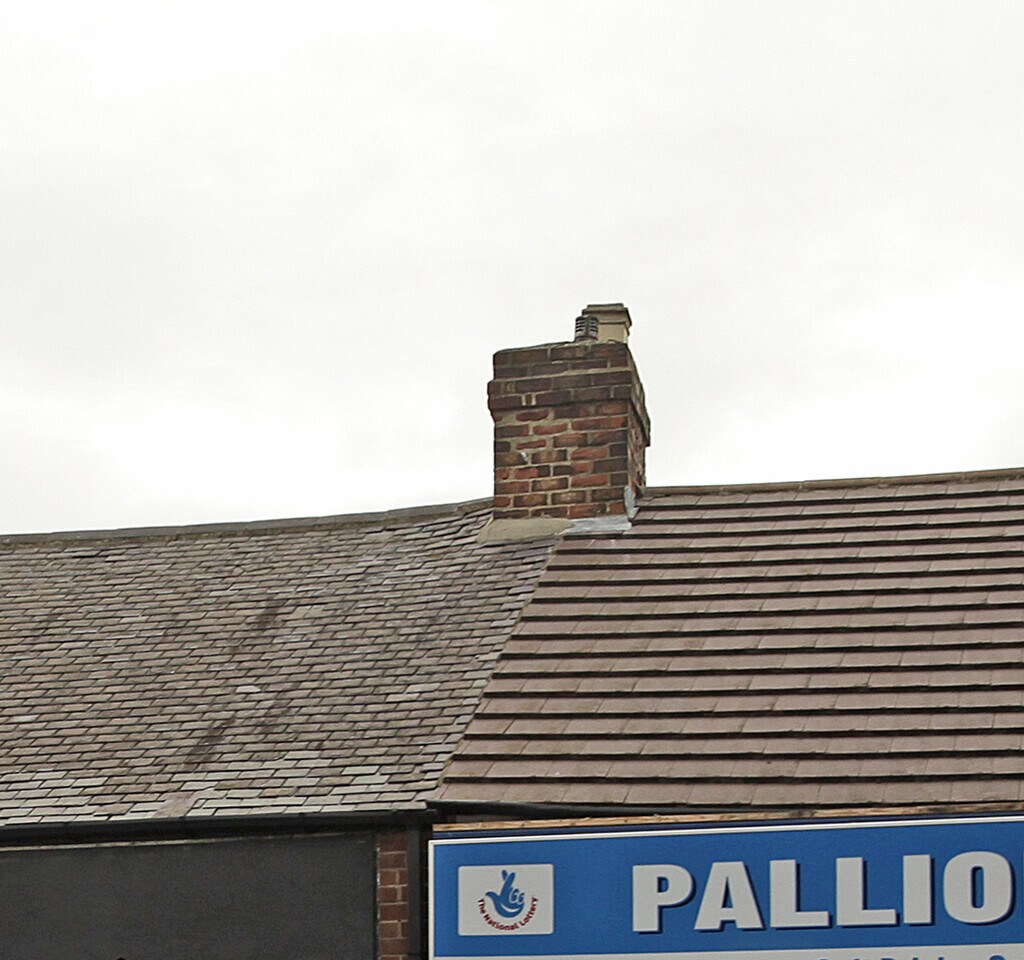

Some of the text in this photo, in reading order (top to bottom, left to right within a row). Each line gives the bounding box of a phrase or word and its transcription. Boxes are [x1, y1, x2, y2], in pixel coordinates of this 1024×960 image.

[478, 896, 538, 930] The National Lottery
